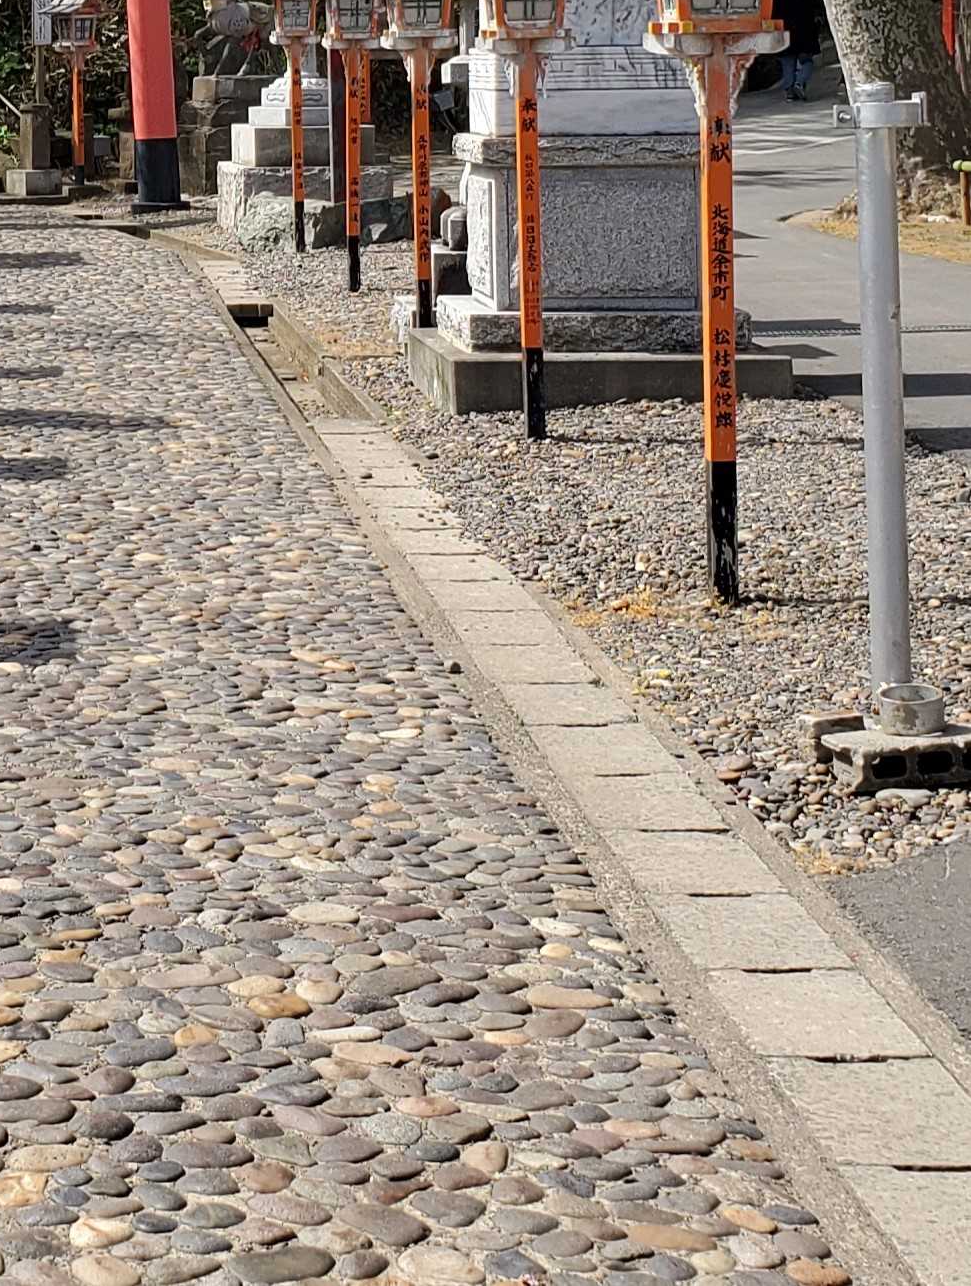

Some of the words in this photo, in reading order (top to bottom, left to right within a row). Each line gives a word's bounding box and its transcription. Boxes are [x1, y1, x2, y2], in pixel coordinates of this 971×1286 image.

[711, 203, 732, 302] 北海道余市町
